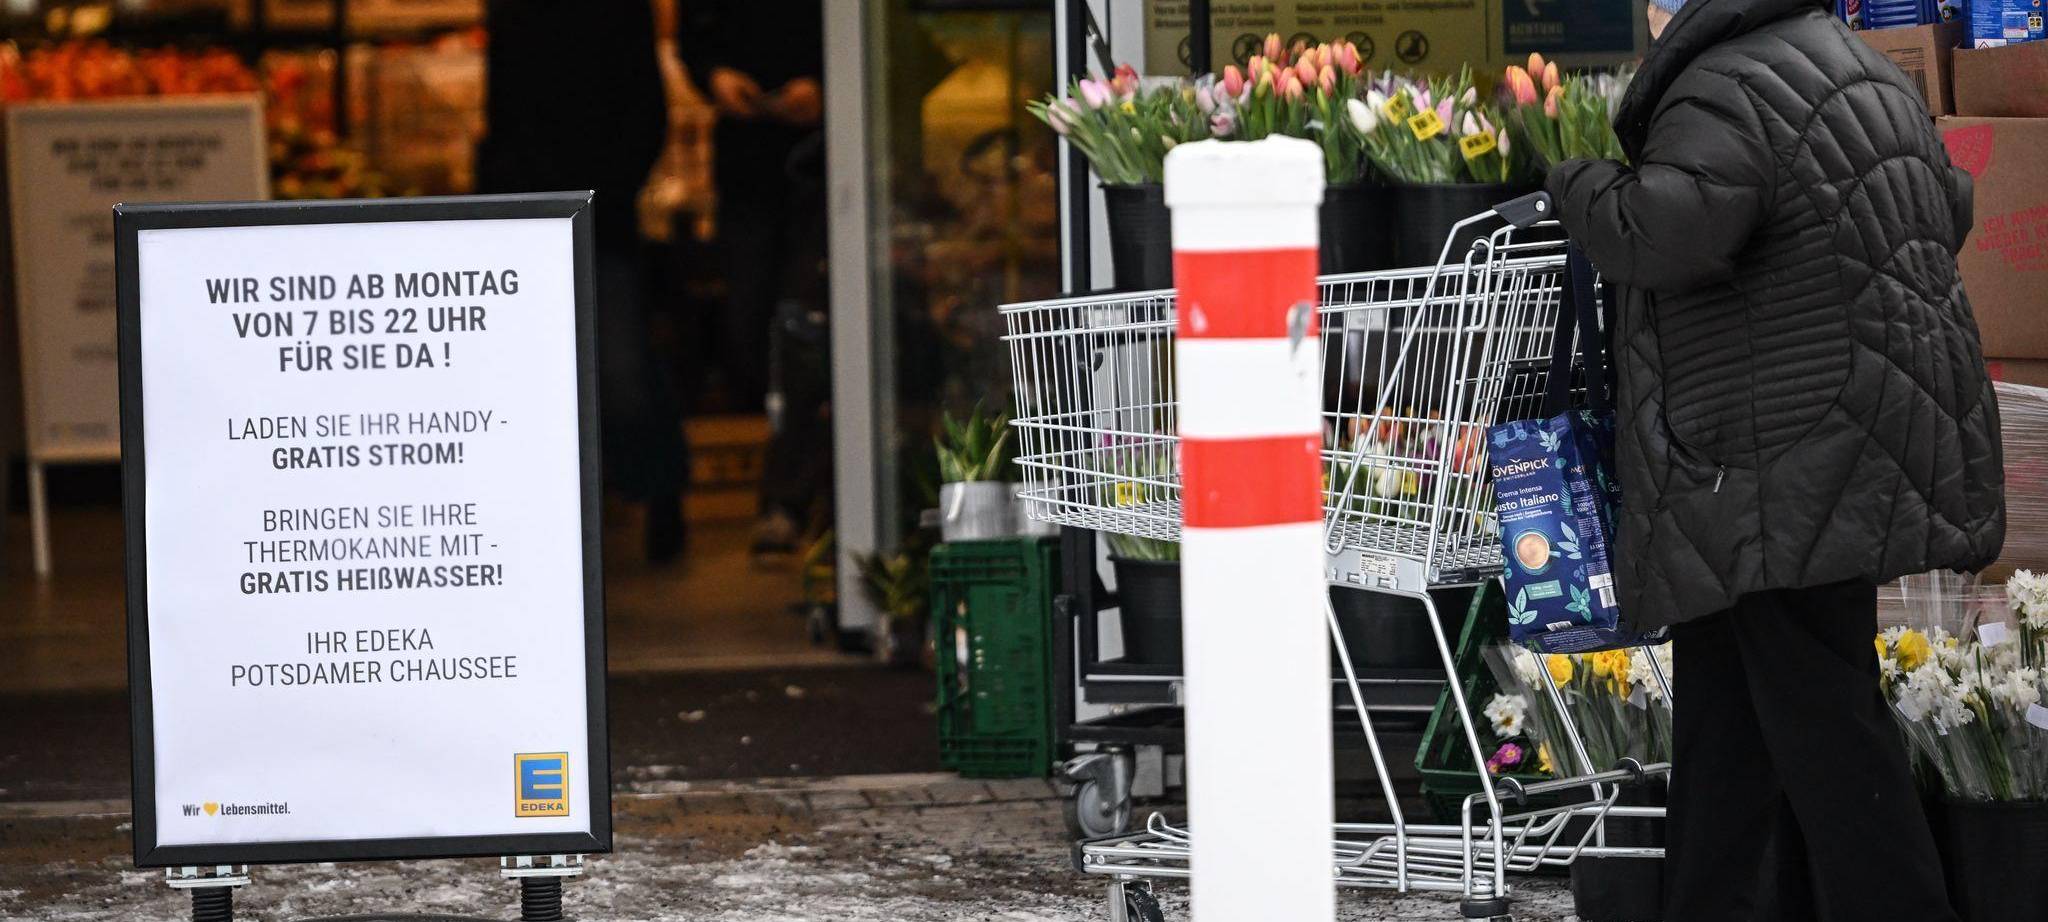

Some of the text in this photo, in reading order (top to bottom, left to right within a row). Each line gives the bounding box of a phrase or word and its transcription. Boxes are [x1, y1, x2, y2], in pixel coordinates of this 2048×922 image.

[205, 268, 519, 305] WIR SIND AB MONTAG
[231, 305, 487, 339] VON 7 BIS 22 UHR
[279, 340, 451, 373] FÜR SIE DA !
[228, 415, 307, 441] LADEN
[315, 414, 352, 438] SIE
[360, 412, 400, 436] IHR
[408, 409, 493, 434] HANDY
[272, 441, 464, 470] GRATIS STROM!
[1492, 457, 1549, 478] ÖVENPICK
[1496, 501, 1518, 513] usto
[1519, 493, 1559, 508] Italiano
[1497, 486, 1543, 499] Crema Intensa
[263, 502, 478, 533] BRINGEN SIE IHRE
[243, 535, 432, 564] THERMOKANNE
[440, 533, 484, 557] MIT
[239, 563, 503, 595] GRATIS HEIßWASSER!
[307, 627, 434, 655] IHR EDEKA
[231, 655, 518, 687] POTSDAMER CHAUSSEE
[182, 801, 291, 817] Wir Lebensmittel.
[520, 802, 565, 812] EDEKA
